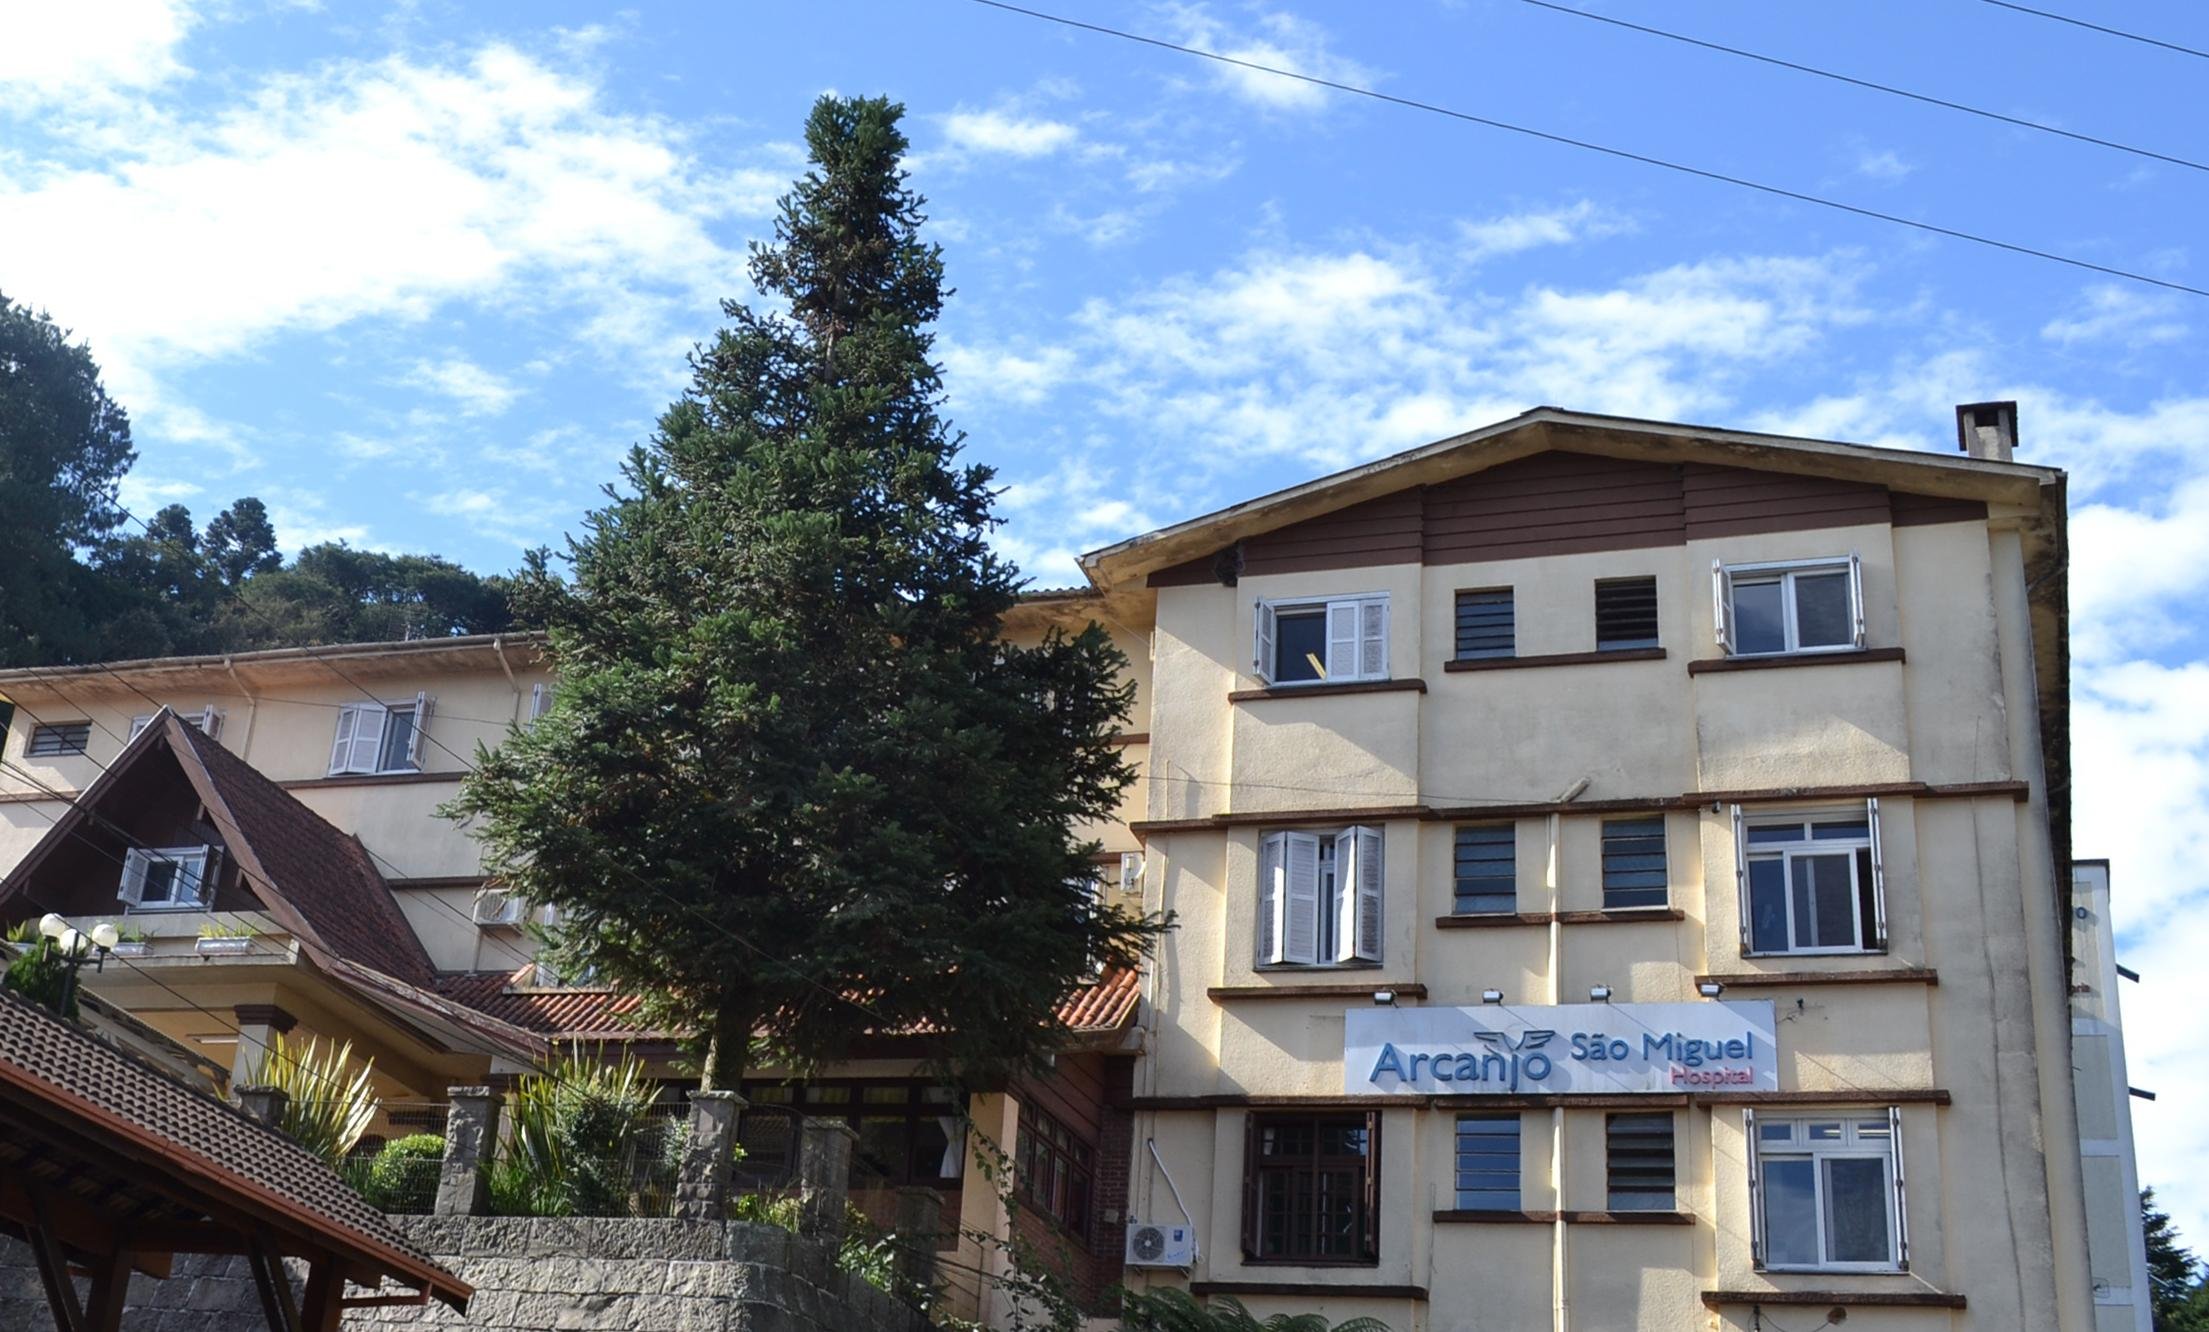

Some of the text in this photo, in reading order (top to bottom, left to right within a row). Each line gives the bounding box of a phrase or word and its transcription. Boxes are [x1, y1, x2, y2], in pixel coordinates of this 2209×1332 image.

[1369, 1031, 1753, 1092] Arcanjo São Miguel
[1671, 1067, 1753, 1089] Hospital
